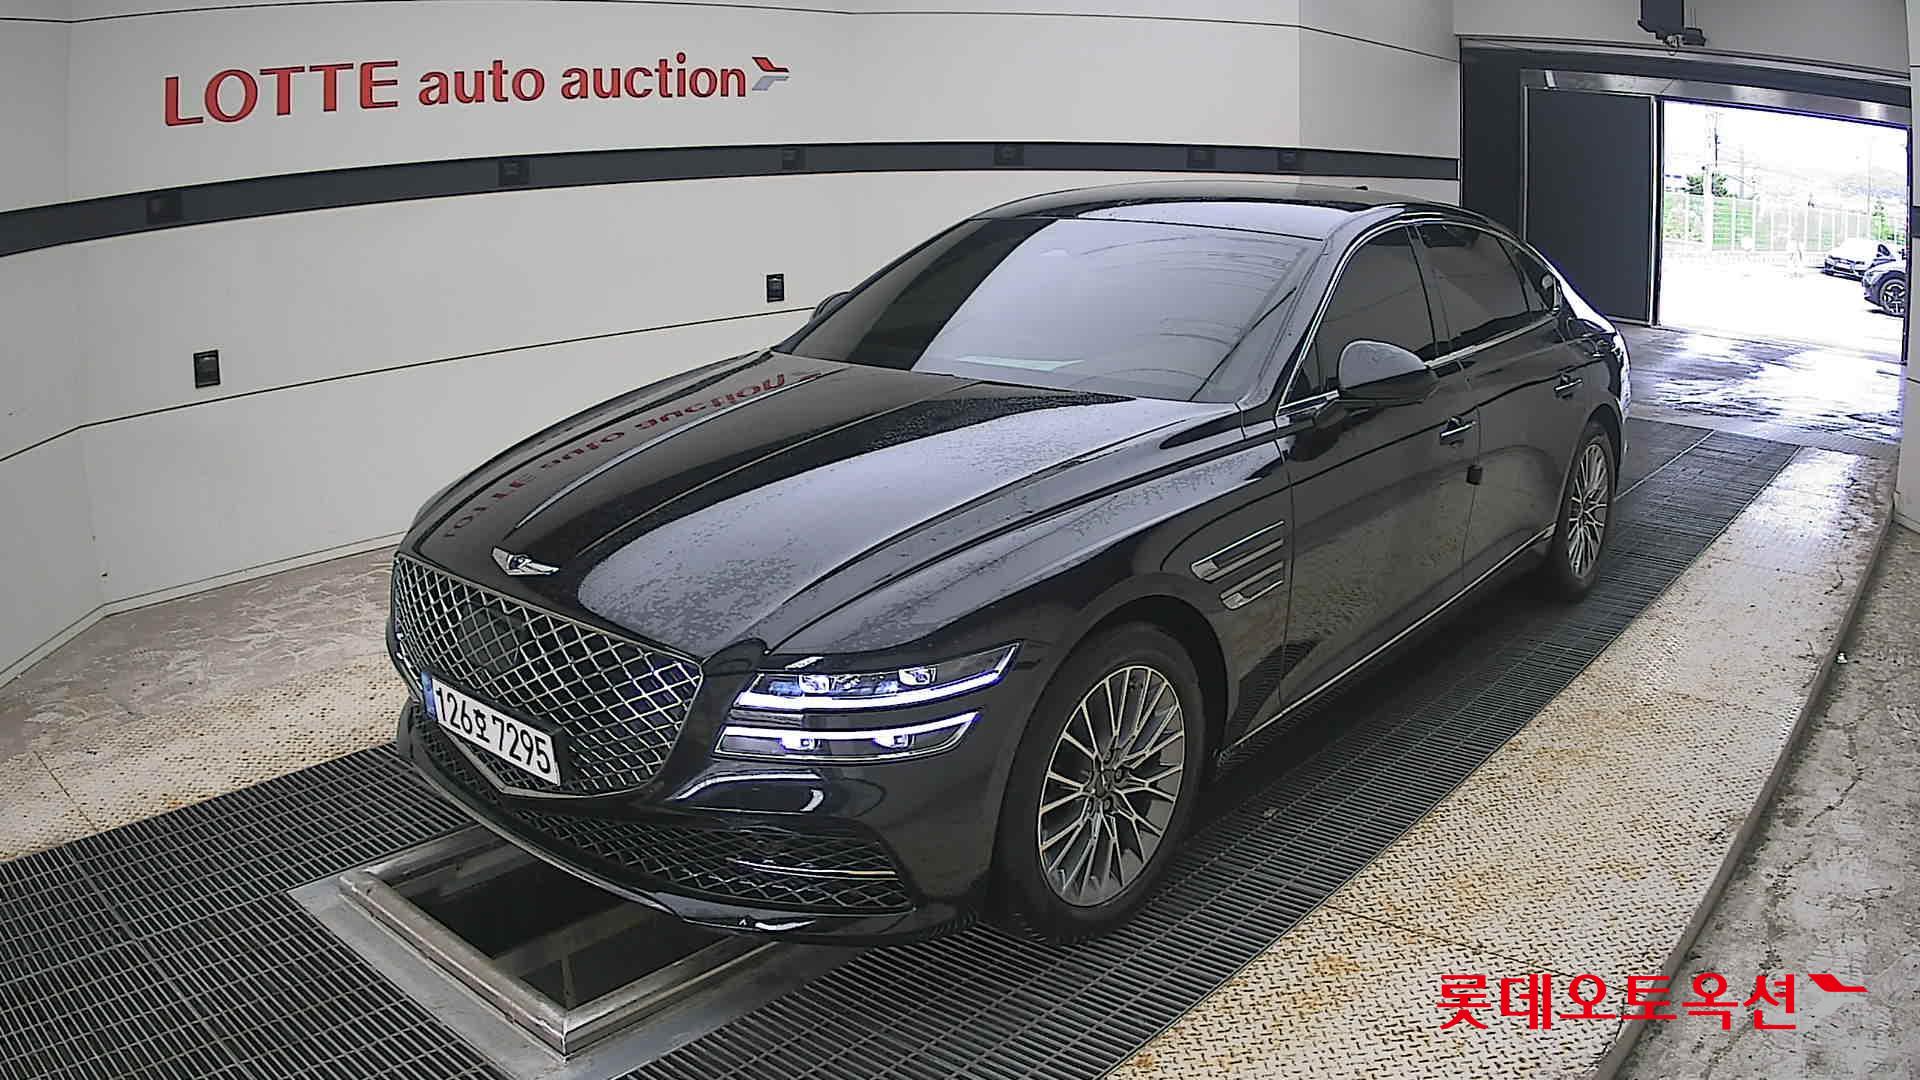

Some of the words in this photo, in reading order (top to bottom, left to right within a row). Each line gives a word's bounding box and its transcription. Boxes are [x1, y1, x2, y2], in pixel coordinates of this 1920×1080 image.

[164, 60, 399, 127] LOTTE
[418, 59, 546, 106] auto
[560, 52, 748, 99] auction
[492, 714, 551, 775] 7295
